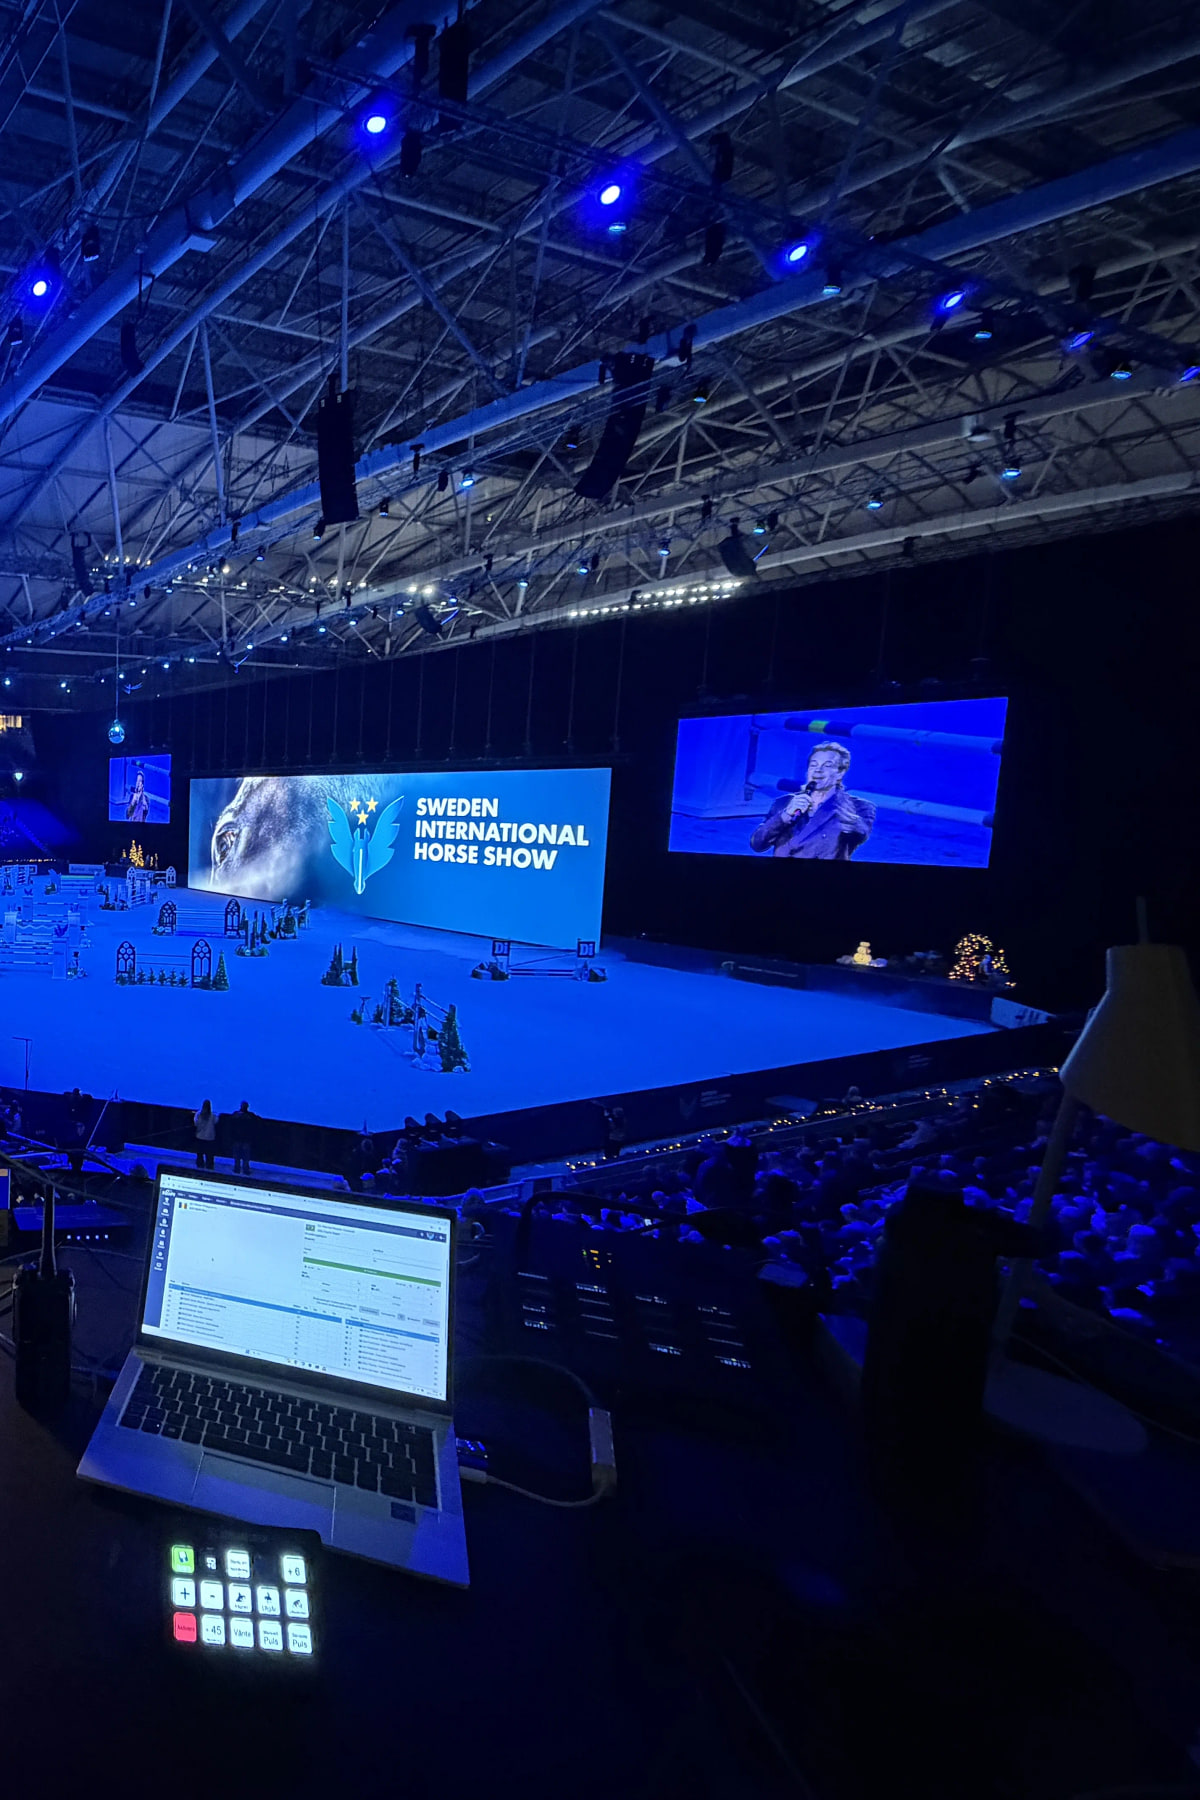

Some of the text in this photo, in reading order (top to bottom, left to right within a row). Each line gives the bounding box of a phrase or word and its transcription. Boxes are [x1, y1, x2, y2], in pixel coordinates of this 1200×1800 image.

[416, 797, 499, 818] SWEDEN
[415, 820, 590, 847] INTERNATIONAL
[414, 843, 558, 870] HORSE SHOW
[495, 941, 509, 955] Di
[580, 943, 594, 956] Di
